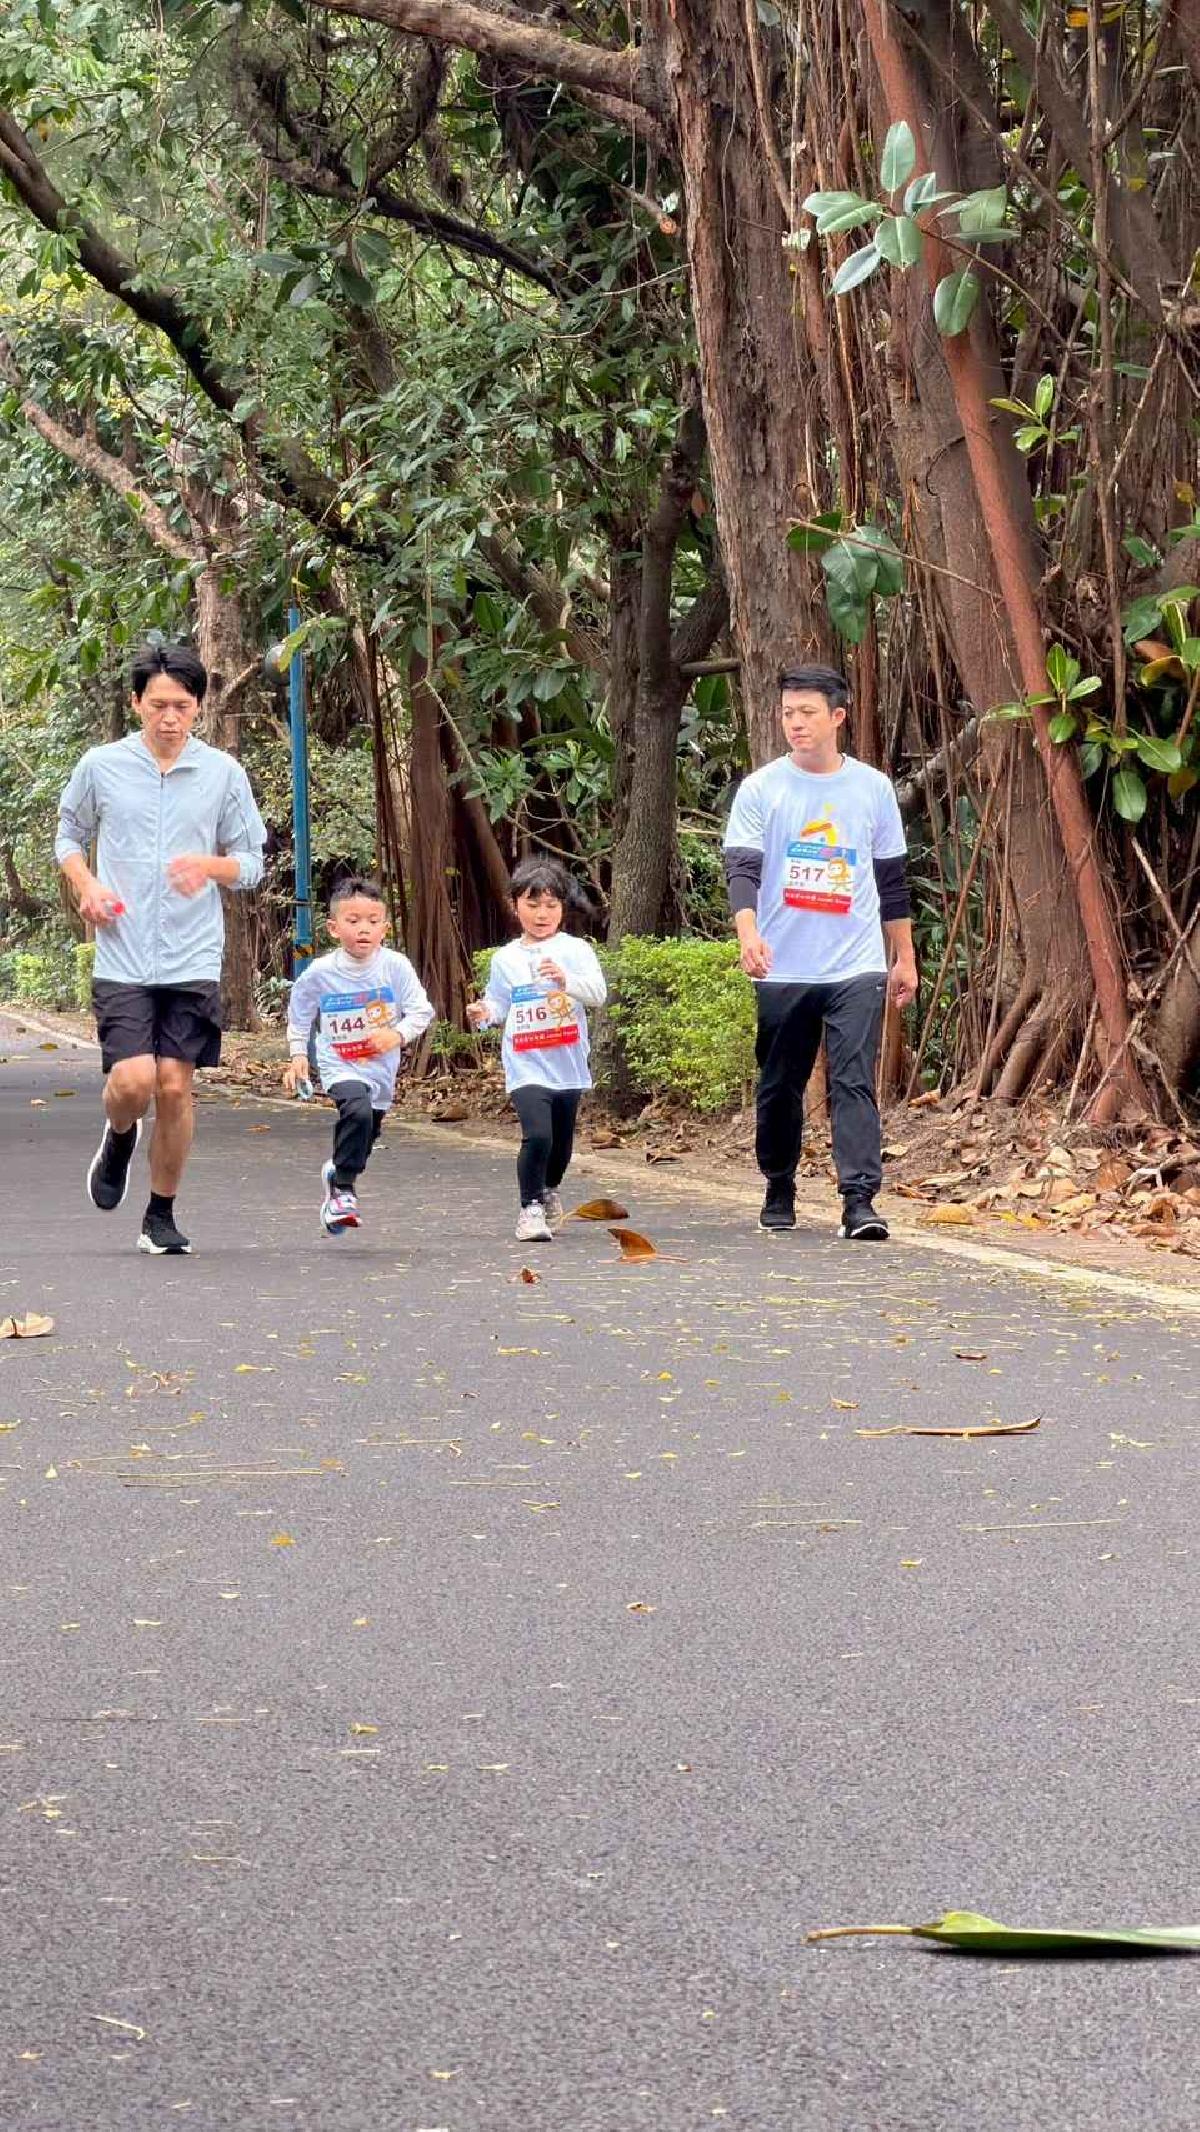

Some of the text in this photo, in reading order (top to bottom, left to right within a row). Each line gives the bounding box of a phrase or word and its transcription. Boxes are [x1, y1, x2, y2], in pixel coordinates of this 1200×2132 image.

[789, 866, 825, 882] 517
[516, 1007, 547, 1024] 516
[330, 1017, 366, 1034] 144
